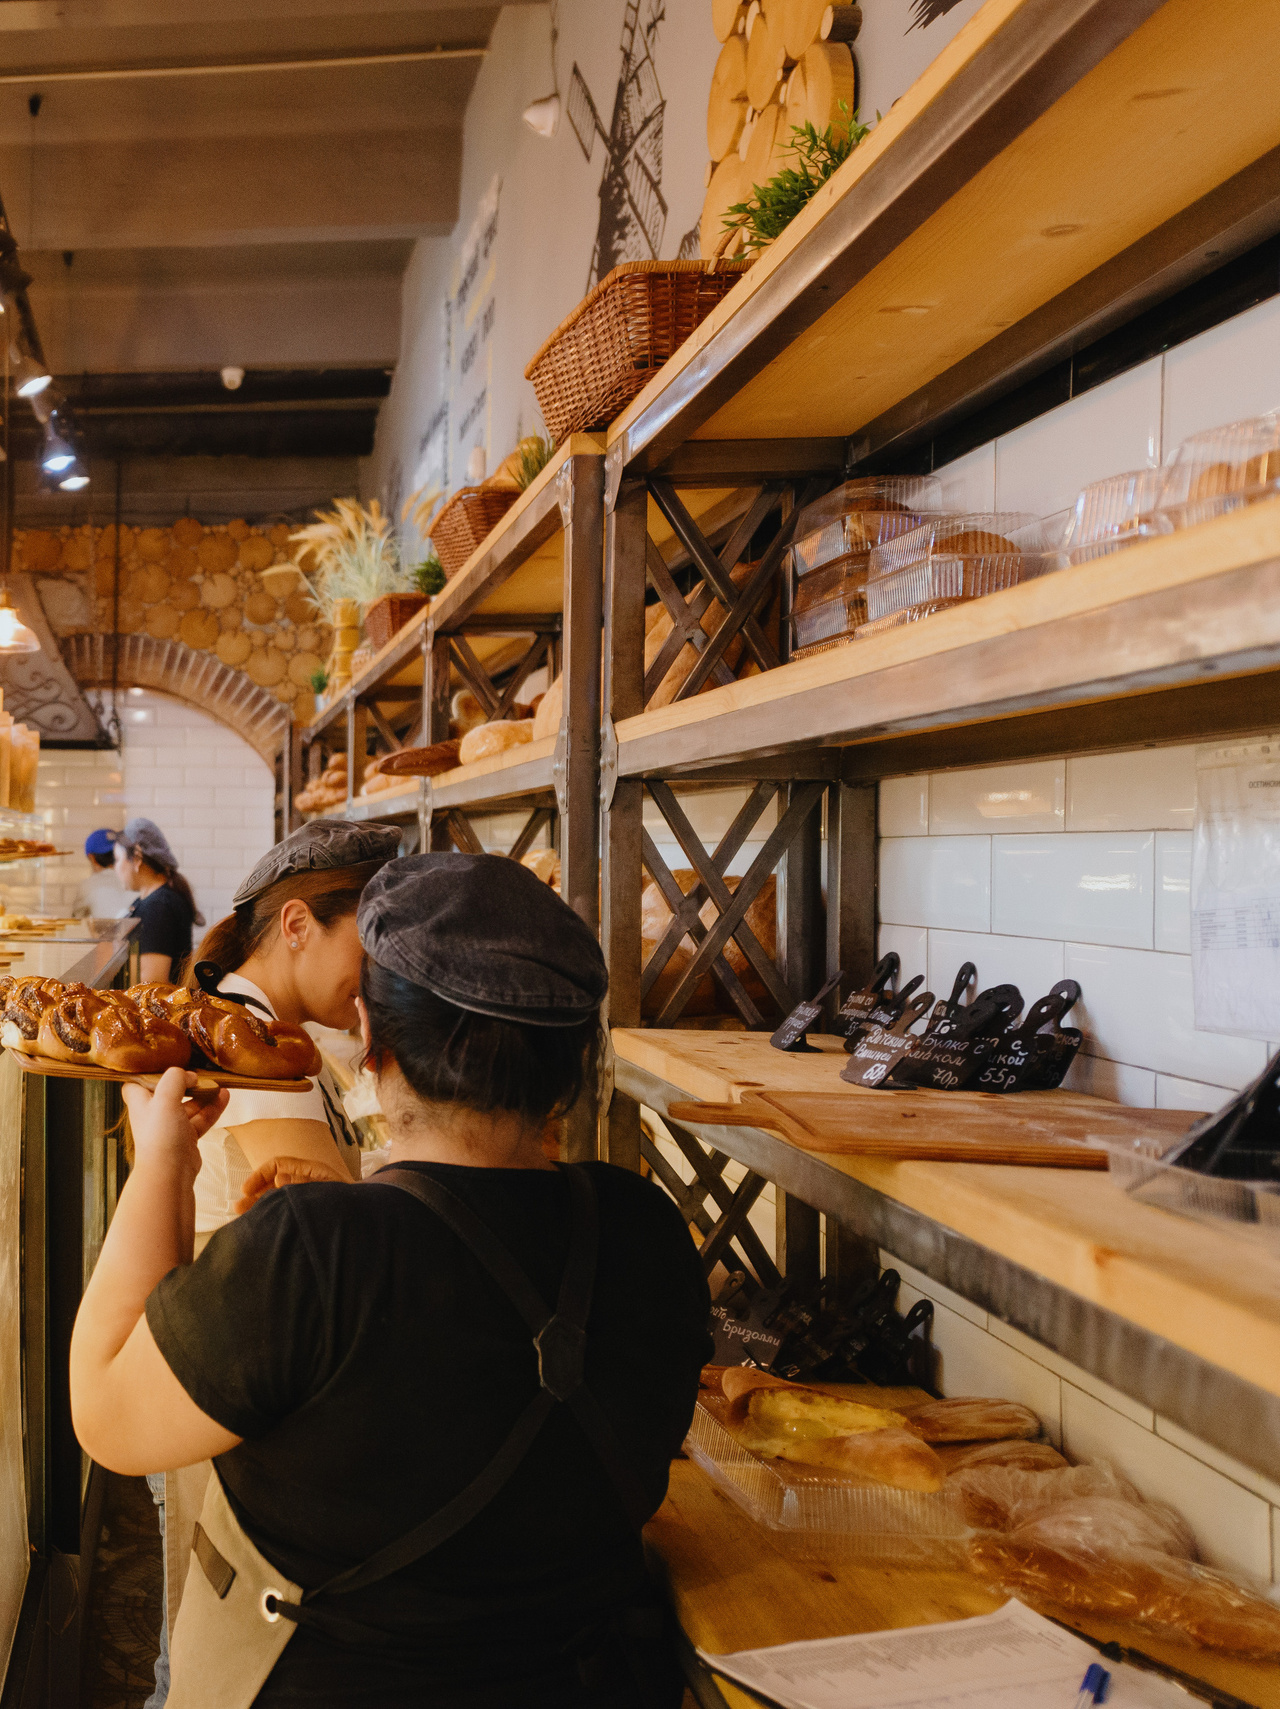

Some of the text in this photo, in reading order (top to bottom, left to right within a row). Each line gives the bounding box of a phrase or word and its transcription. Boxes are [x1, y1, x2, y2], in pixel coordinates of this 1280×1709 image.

[904, 1040, 913, 1050] с
[923, 1033, 970, 1054] Булка
[973, 1044, 983, 1055] с
[862, 1063, 888, 1086] 60р
[932, 1067, 959, 1089] 70р
[979, 1067, 1017, 1090] 55р
[722, 1318, 781, 1347] Бризолли
